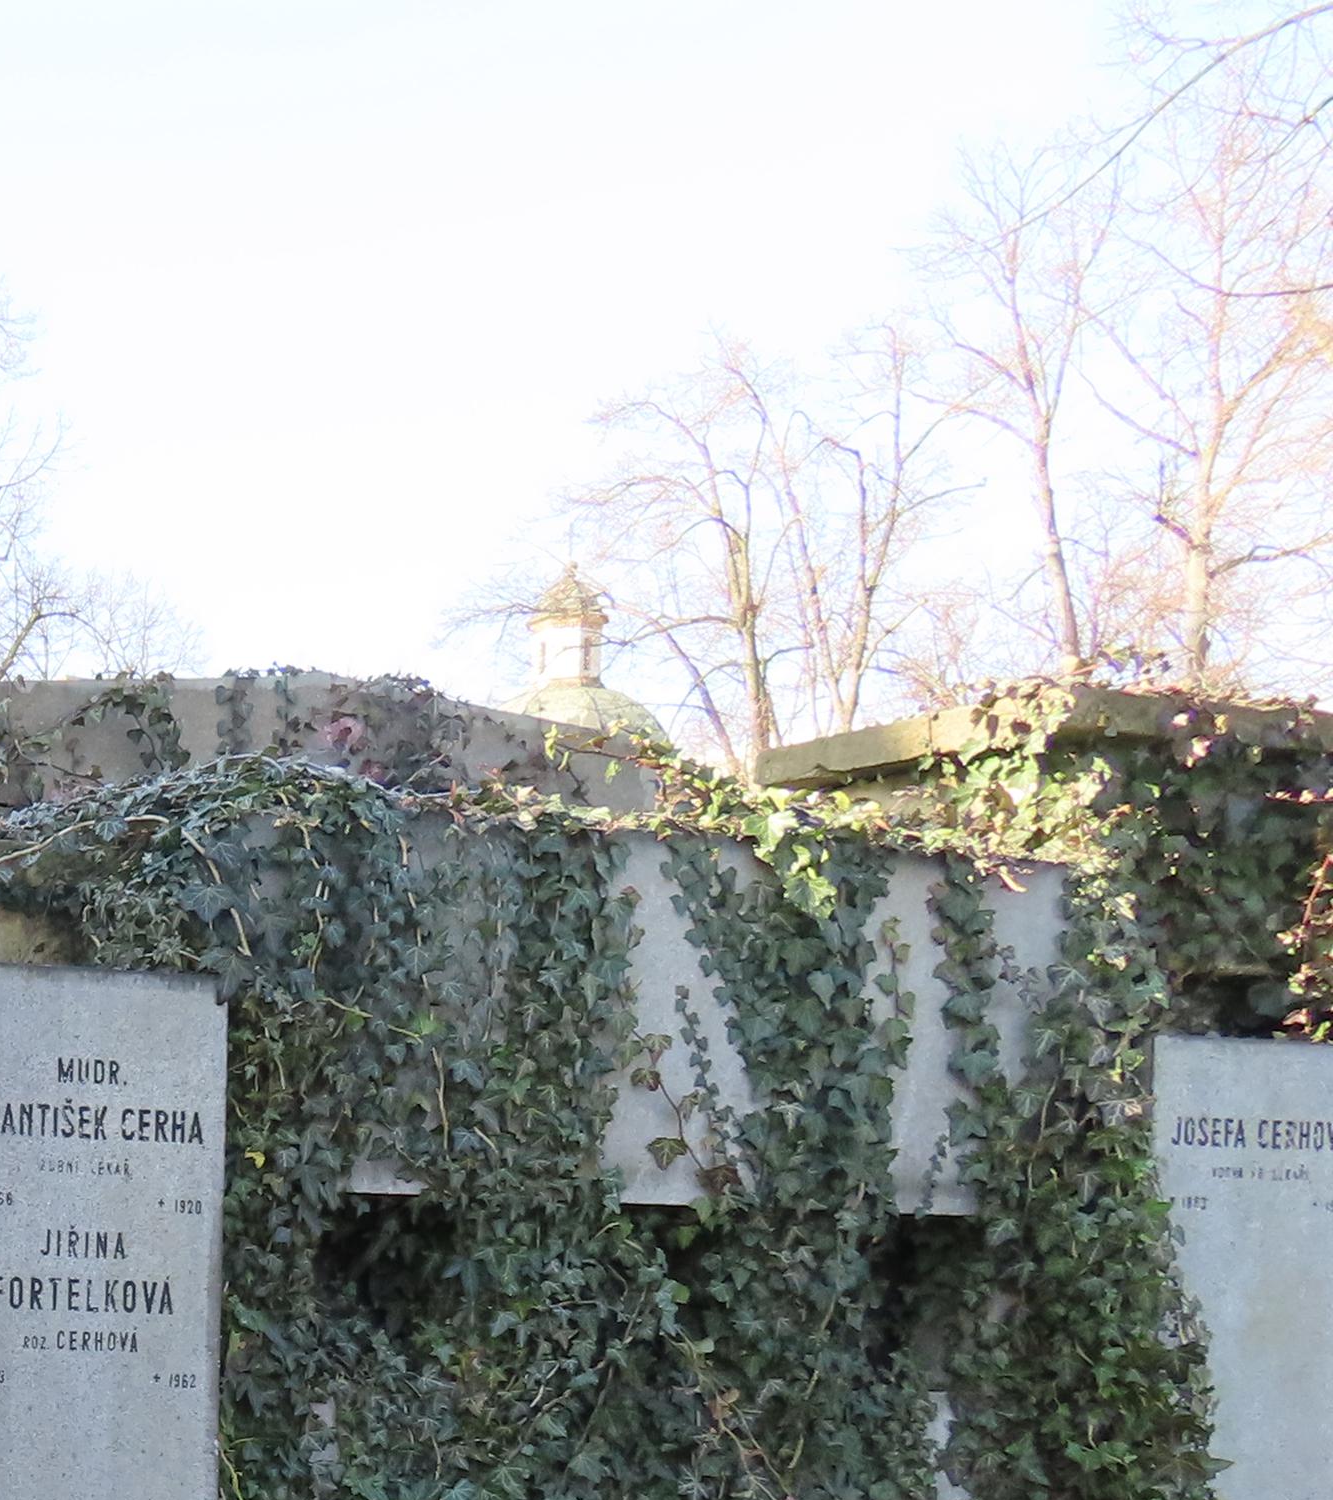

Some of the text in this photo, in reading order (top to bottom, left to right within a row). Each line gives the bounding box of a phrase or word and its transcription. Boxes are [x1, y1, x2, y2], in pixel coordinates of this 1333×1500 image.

[57, 1056, 129, 1087] MUDR.
[120, 1107, 206, 1145] CERHA
[1171, 1116, 1247, 1148] JOSEFA
[174, 1198, 203, 1215] 1920
[39, 1224, 129, 1260] JIŘINA
[56, 1326, 139, 1353] CERHOVÁ
[168, 1373, 197, 1389] 1962
